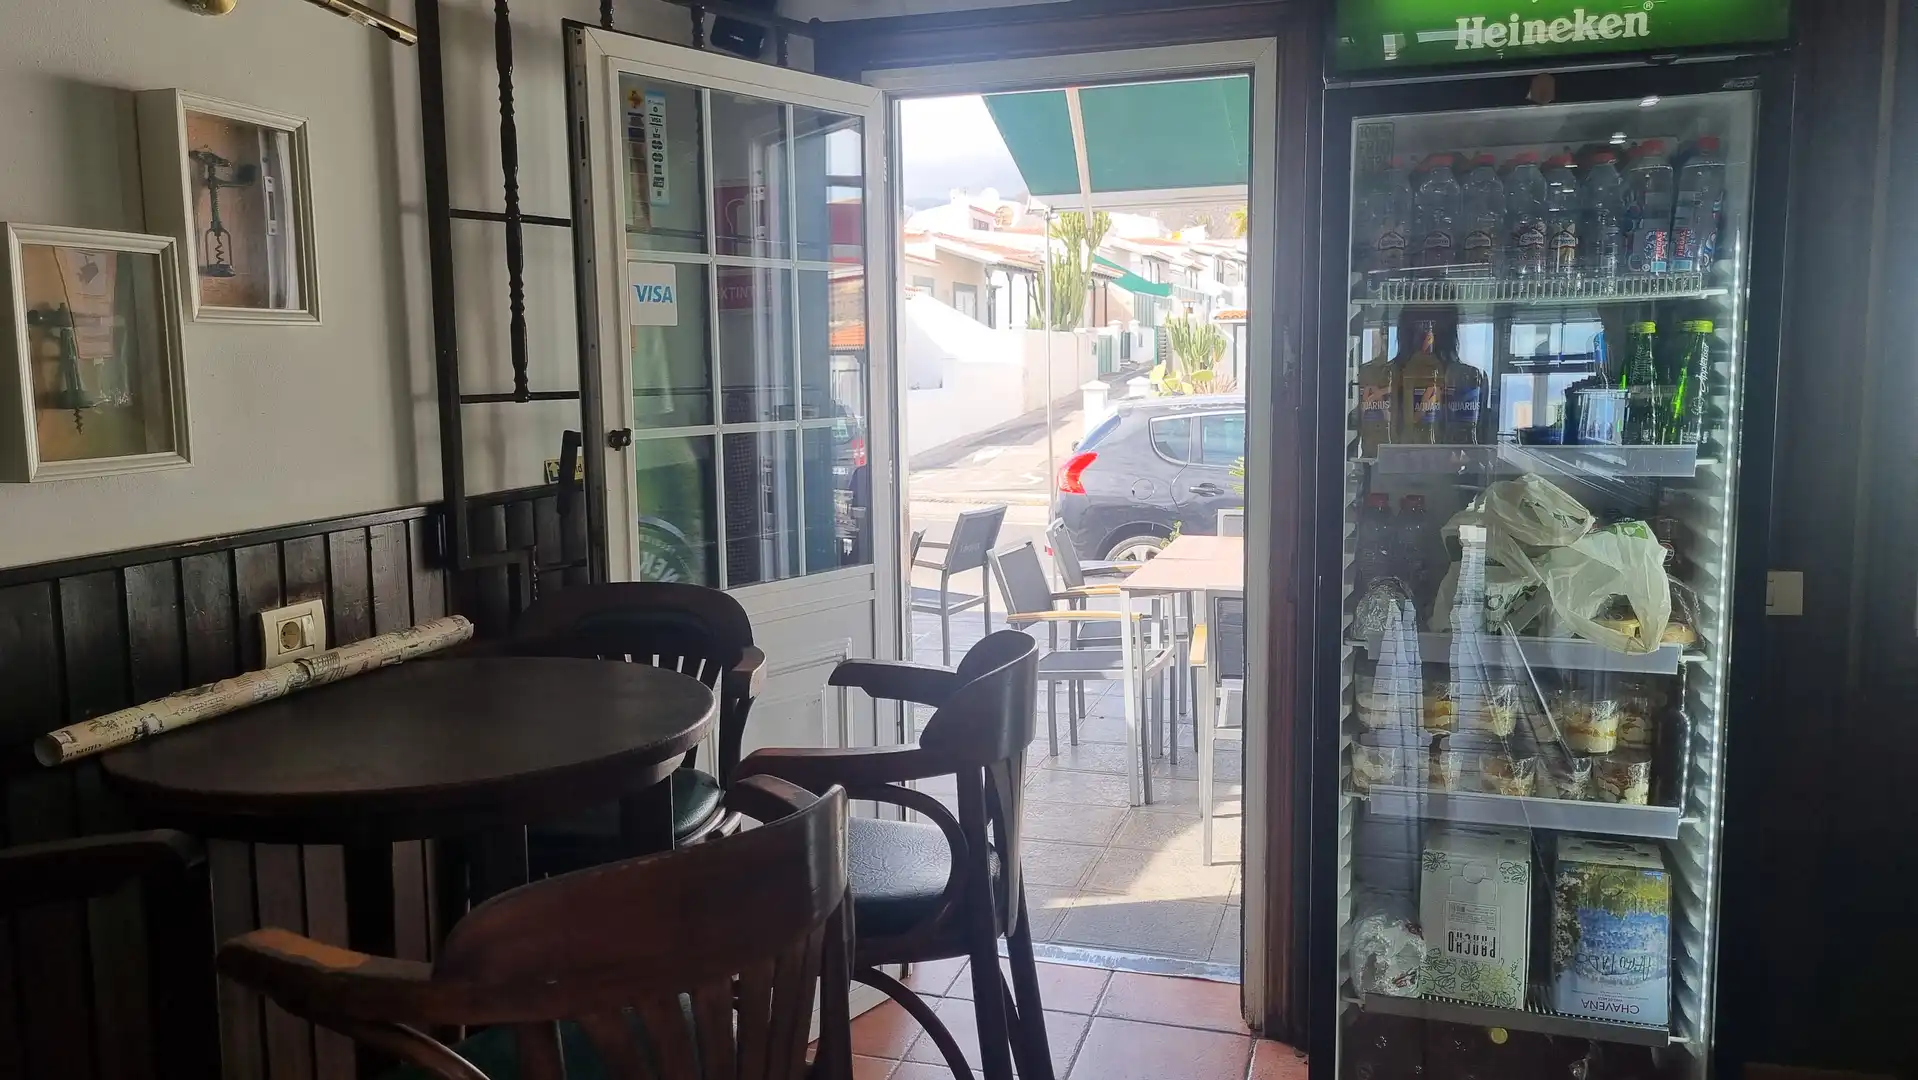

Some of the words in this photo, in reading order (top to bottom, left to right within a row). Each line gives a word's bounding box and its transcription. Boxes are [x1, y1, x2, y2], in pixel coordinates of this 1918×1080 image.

[1455, 9, 1650, 50] Heineken
[633, 284, 673, 303] VISA
[1448, 931, 1496, 958] PANCHO
[1581, 998, 1640, 1014] CHAVEÑA
